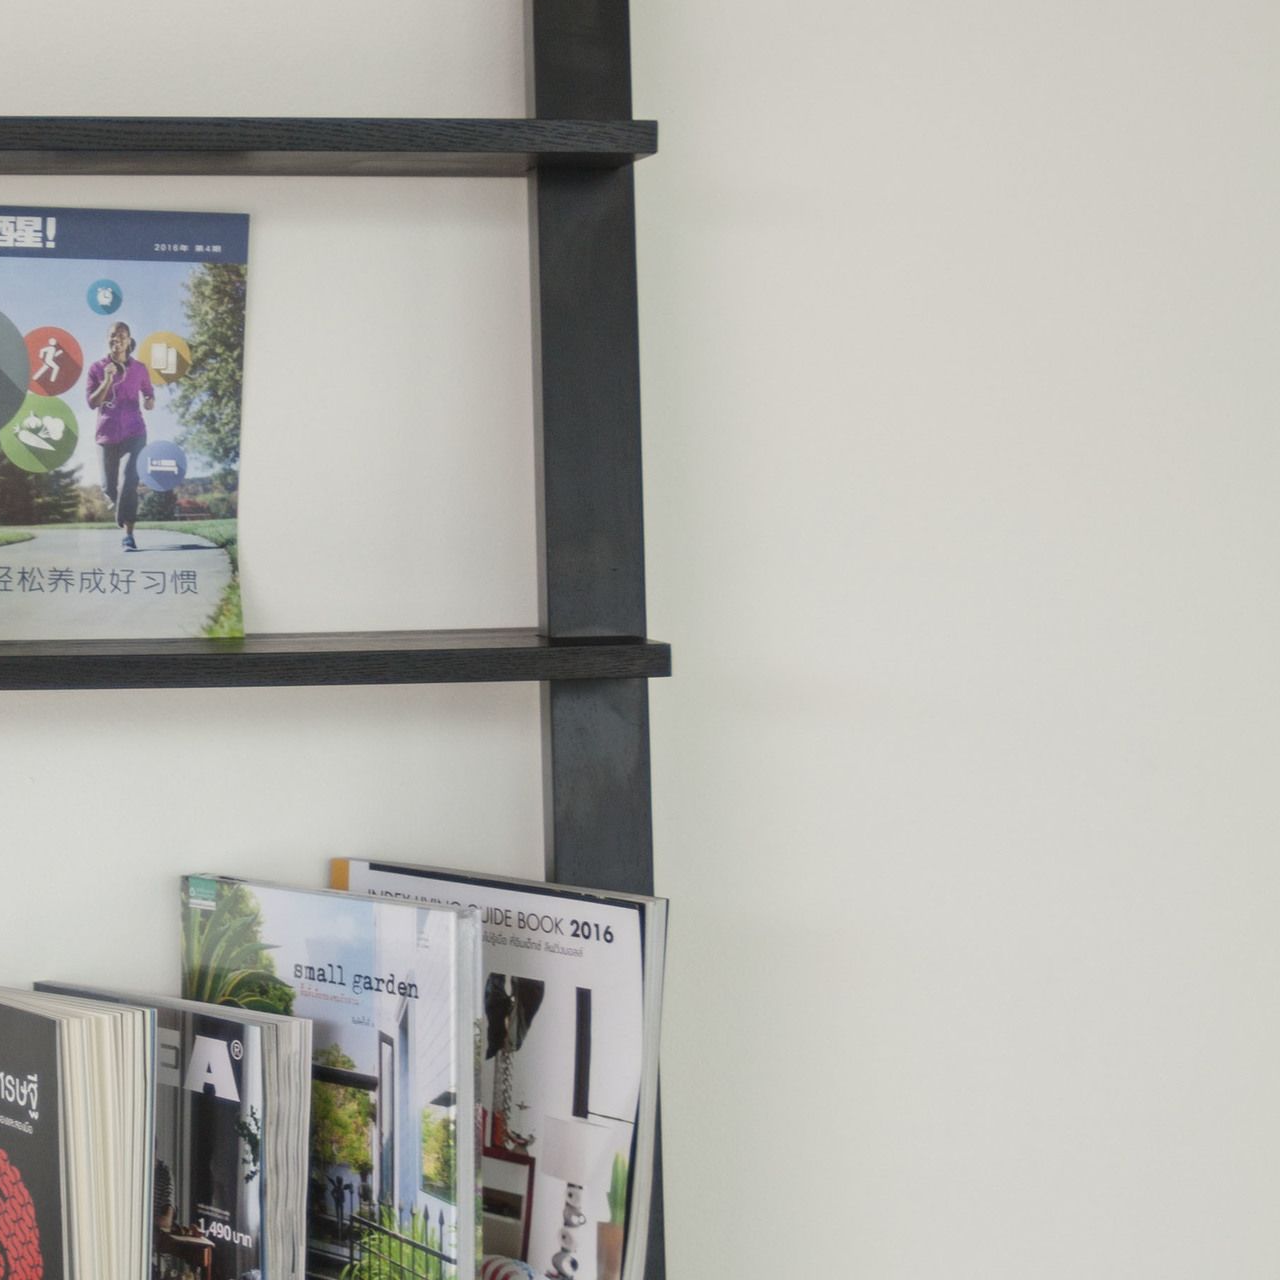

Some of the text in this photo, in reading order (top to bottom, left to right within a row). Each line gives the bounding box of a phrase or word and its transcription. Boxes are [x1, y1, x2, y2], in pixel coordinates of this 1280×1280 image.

[518, 911, 564, 936] BOOK
[570, 919, 614, 944] 2016
[294, 963, 346, 986] small
[352, 973, 419, 999] garden
[198, 1218, 232, 1241] 1,490
